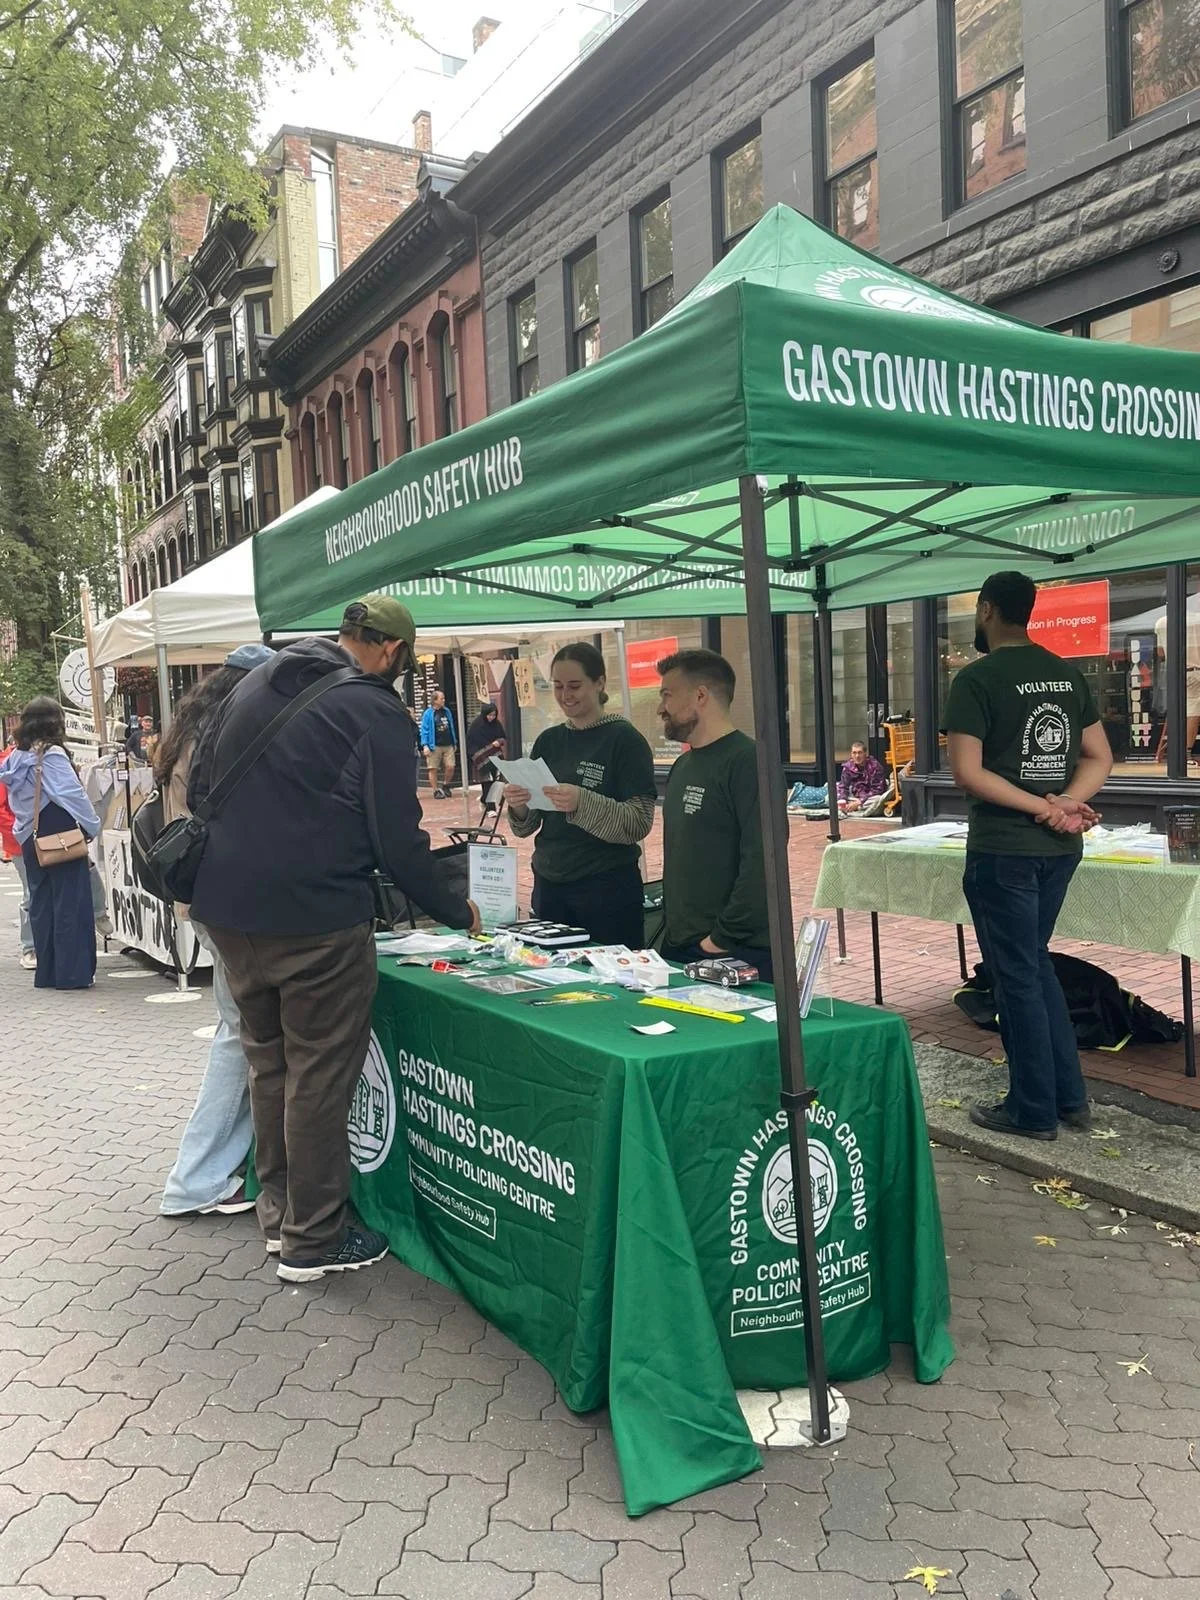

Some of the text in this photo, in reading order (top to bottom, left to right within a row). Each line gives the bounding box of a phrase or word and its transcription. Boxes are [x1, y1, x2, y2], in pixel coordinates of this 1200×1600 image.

[782, 339, 1200, 440] GASTOWN HASTINGS CROSSIN
[325, 436, 523, 565] NEIGHBOURHOOD SAFETY HUB
[1046, 617, 1054, 627] in
[1056, 614, 1097, 629] Progress
[399, 1049, 475, 1109] GASTOWN
[402, 1084, 576, 1195] HASTINGS CROSSING
[451, 1197, 475, 1220] Safety
[475, 1208, 490, 1226] Hub
[456, 1158, 507, 1196] POLICING
[509, 1182, 556, 1222] CENTRE
[730, 1104, 867, 1265] GASTOWN HASNGS CROSSING
[732, 1278, 801, 1305] POLICIN
[847, 1284, 865, 1300] Hub
